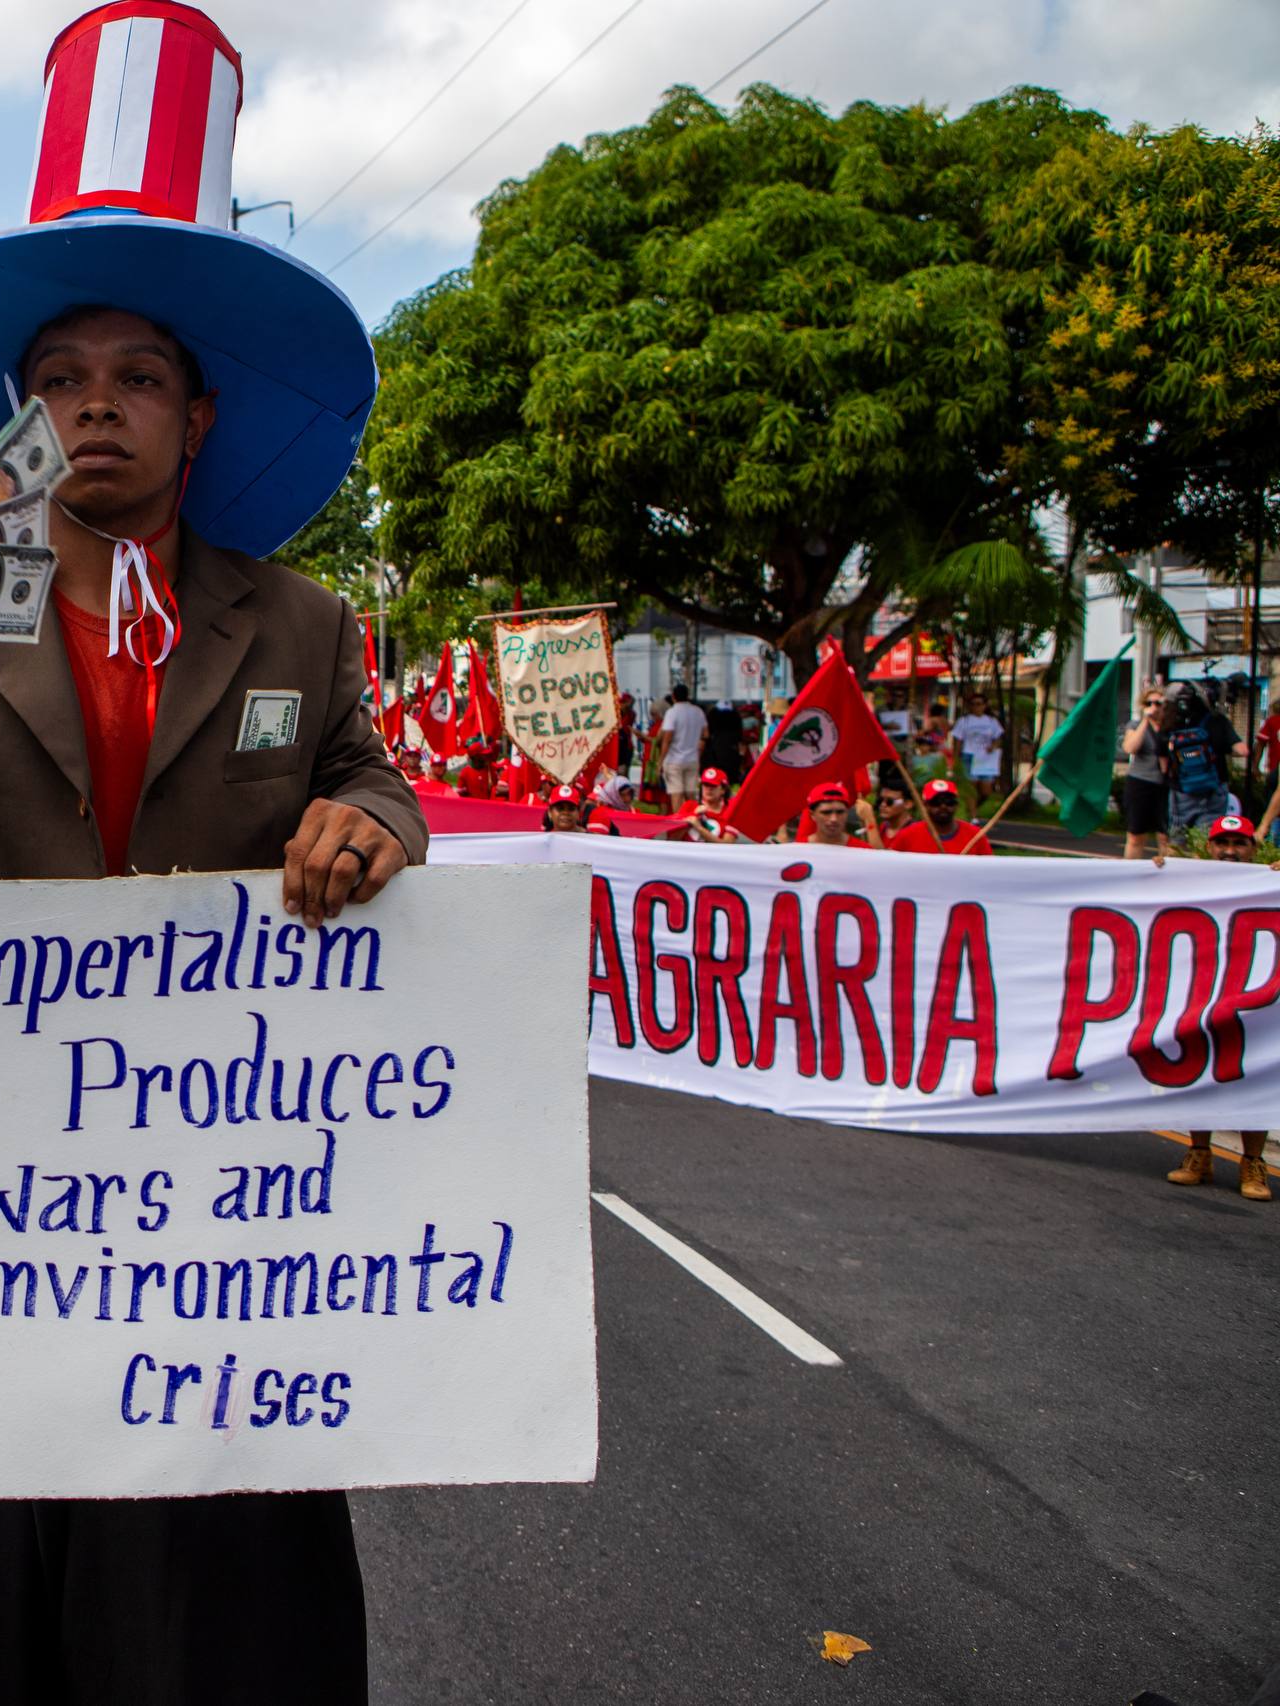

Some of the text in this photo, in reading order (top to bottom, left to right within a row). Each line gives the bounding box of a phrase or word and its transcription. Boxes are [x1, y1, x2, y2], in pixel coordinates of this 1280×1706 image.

[513, 703, 605, 738] FELIZ
[541, 671, 608, 703] POVO
[588, 861, 999, 1097] AGRÁRIA
[60, 1012, 456, 1132] Produces
[212, 1129, 337, 1221] and
